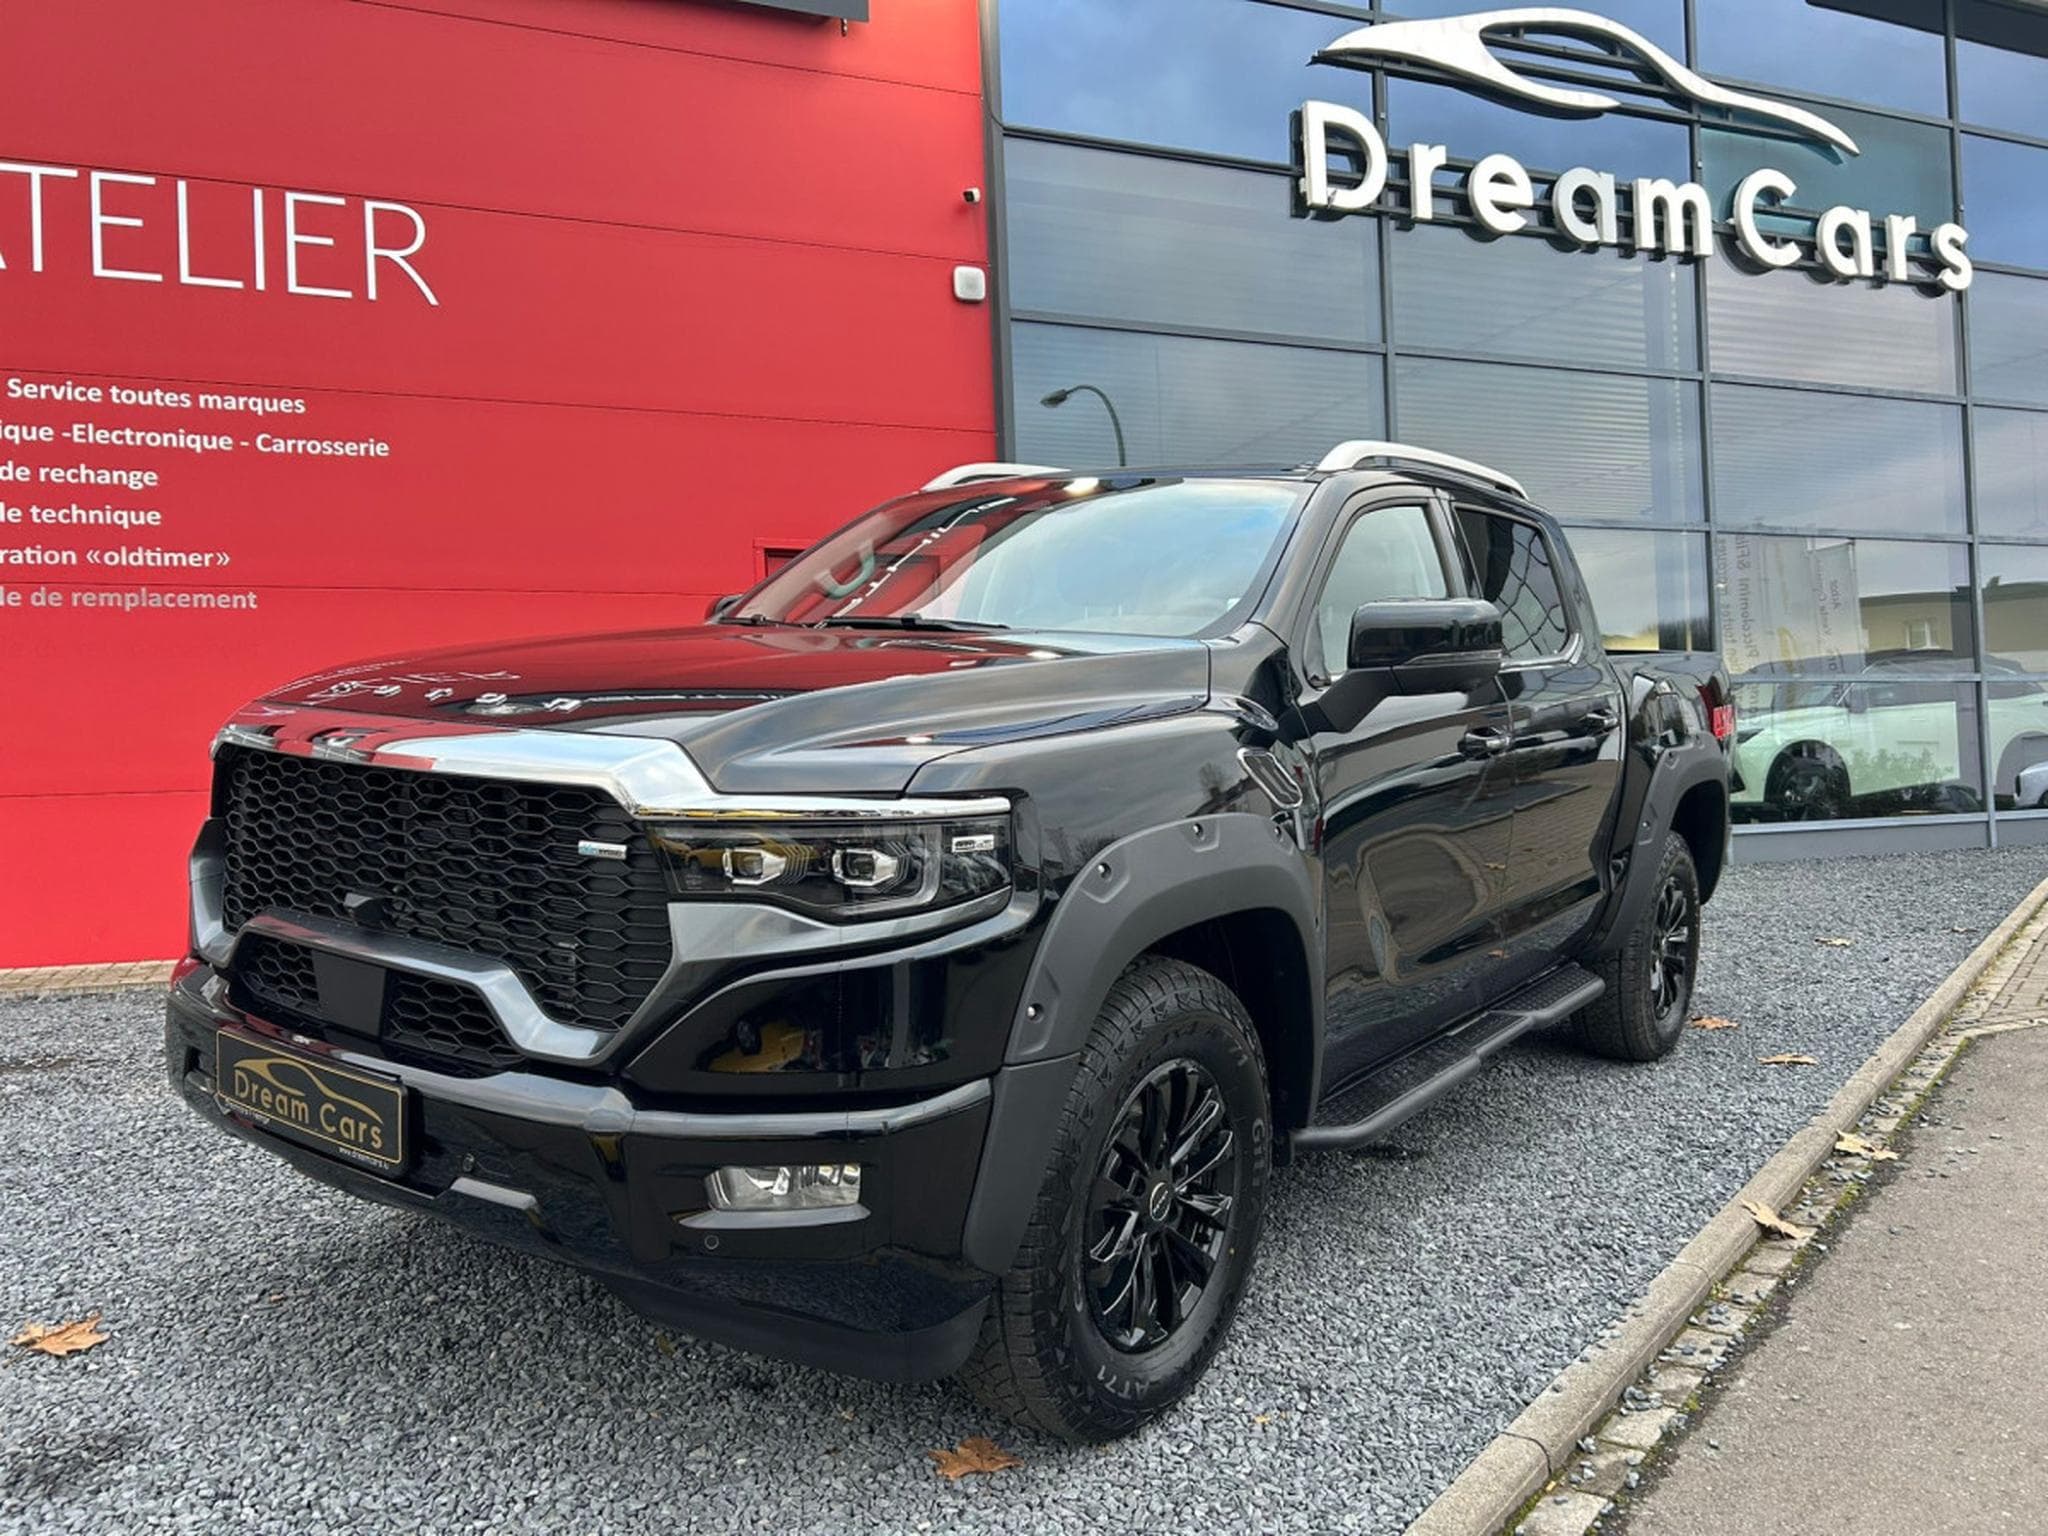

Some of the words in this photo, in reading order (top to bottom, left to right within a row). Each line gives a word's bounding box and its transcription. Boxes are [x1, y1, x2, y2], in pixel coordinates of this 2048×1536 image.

[1299, 101, 1714, 258] Dream
[1732, 168, 1975, 293] Cars
[0, 161, 440, 306] TELIER
[7, 378, 102, 403] Service
[109, 385, 192, 409] toutes
[199, 393, 306, 416] marques
[256, 433, 390, 457] Carrosserie
[39, 463, 159, 490] rechange
[29, 504, 162, 529] technique
[86, 546, 230, 567] «oldtimer»
[30, 586, 63, 608] de
[71, 587, 258, 612] remplacement
[234, 1069, 310, 1125] Dream
[320, 1103, 383, 1150] Cars
